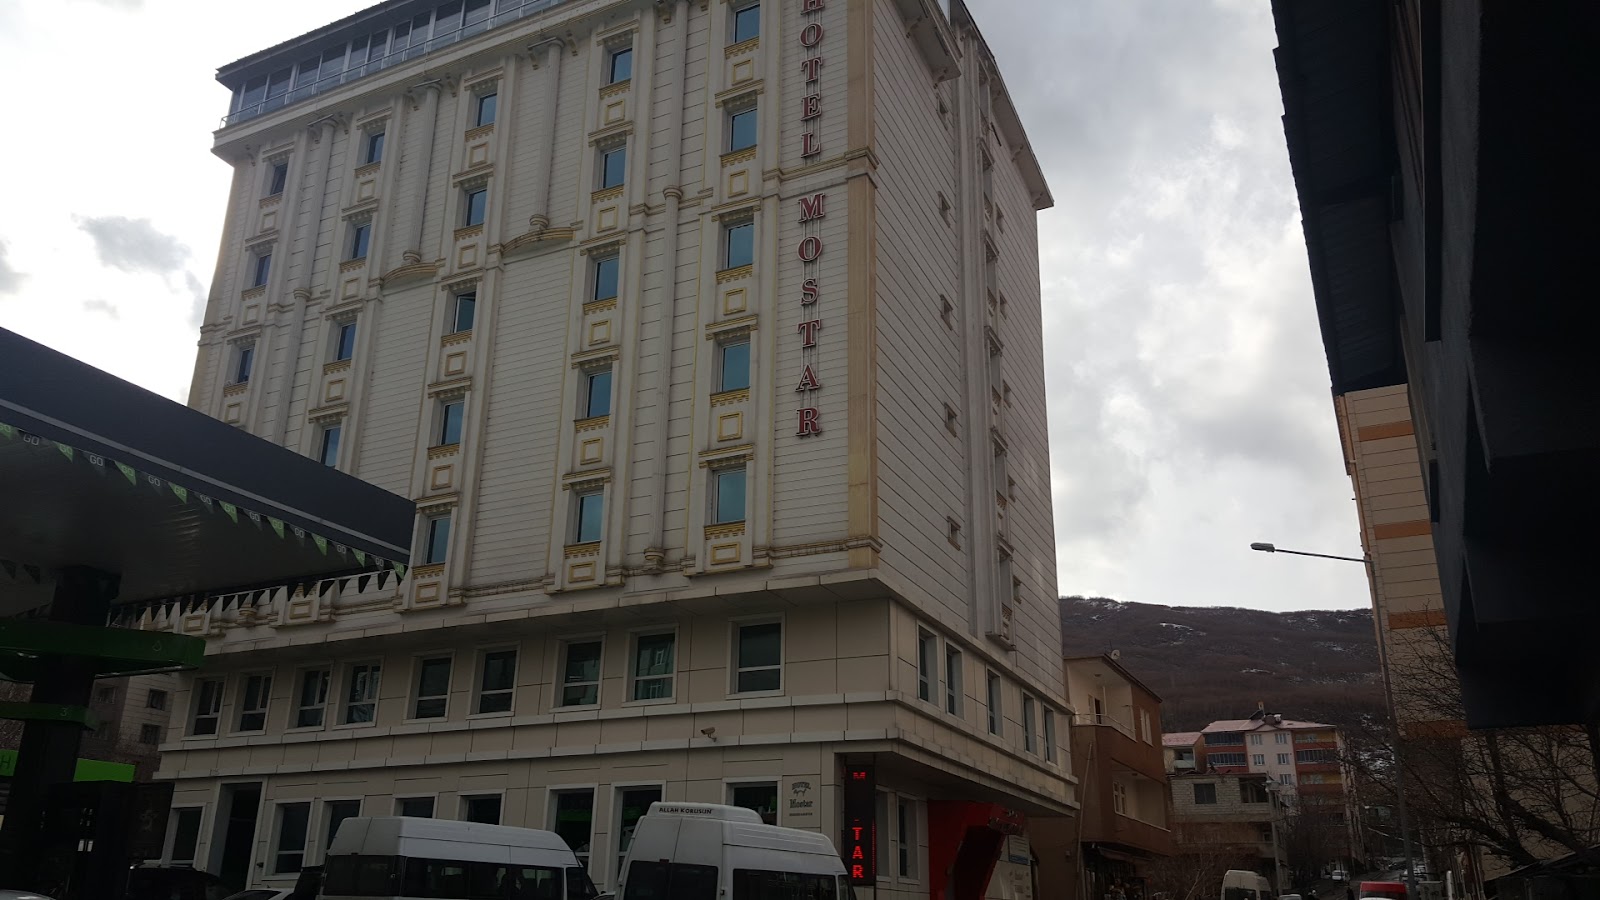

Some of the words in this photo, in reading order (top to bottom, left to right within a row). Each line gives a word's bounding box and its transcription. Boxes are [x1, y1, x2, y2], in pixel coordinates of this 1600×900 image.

[796, 193, 825, 436] MOSTAR
[89, 454, 104, 467] GO
[148, 475, 161, 487] GO
